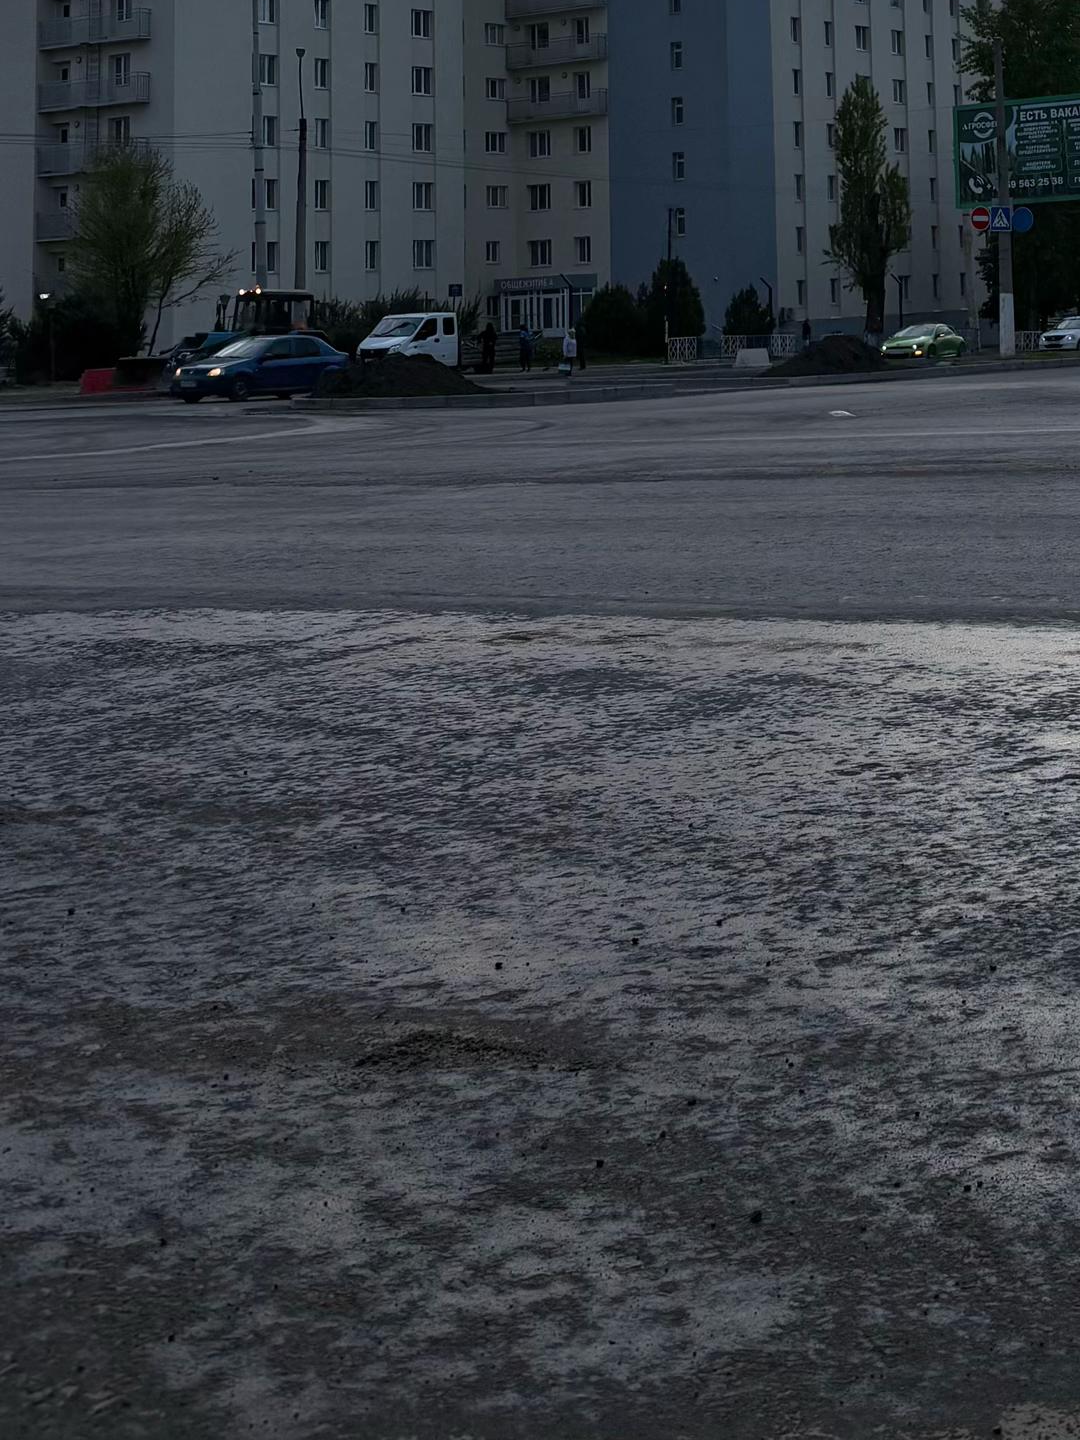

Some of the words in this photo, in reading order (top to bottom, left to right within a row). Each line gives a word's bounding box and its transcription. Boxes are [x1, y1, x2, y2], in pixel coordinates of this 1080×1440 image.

[1020, 110, 1047, 121] ЕСТЬ
[1038, 178, 1050, 186] 25
[1051, 176, 1064, 185] 38
